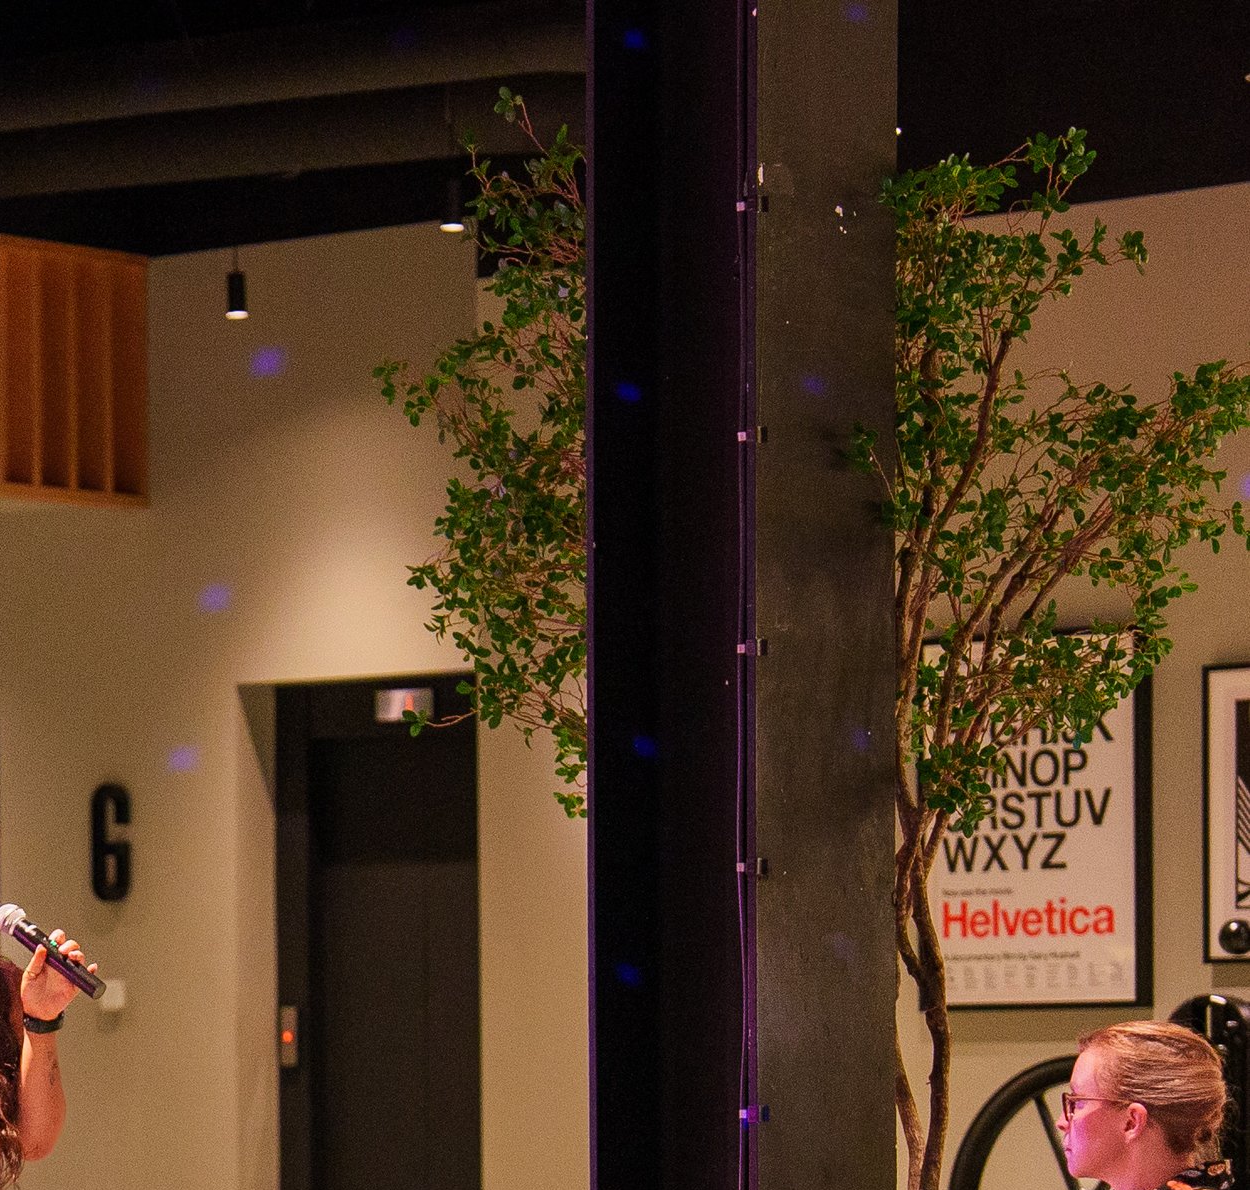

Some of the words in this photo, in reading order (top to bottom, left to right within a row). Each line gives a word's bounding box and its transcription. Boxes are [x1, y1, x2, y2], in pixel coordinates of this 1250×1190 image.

[947, 788, 1111, 830] RSTUV
[91, 784, 131, 901] 6
[942, 833, 1067, 873] WXYZ
[943, 897, 1115, 938] Helvetica
